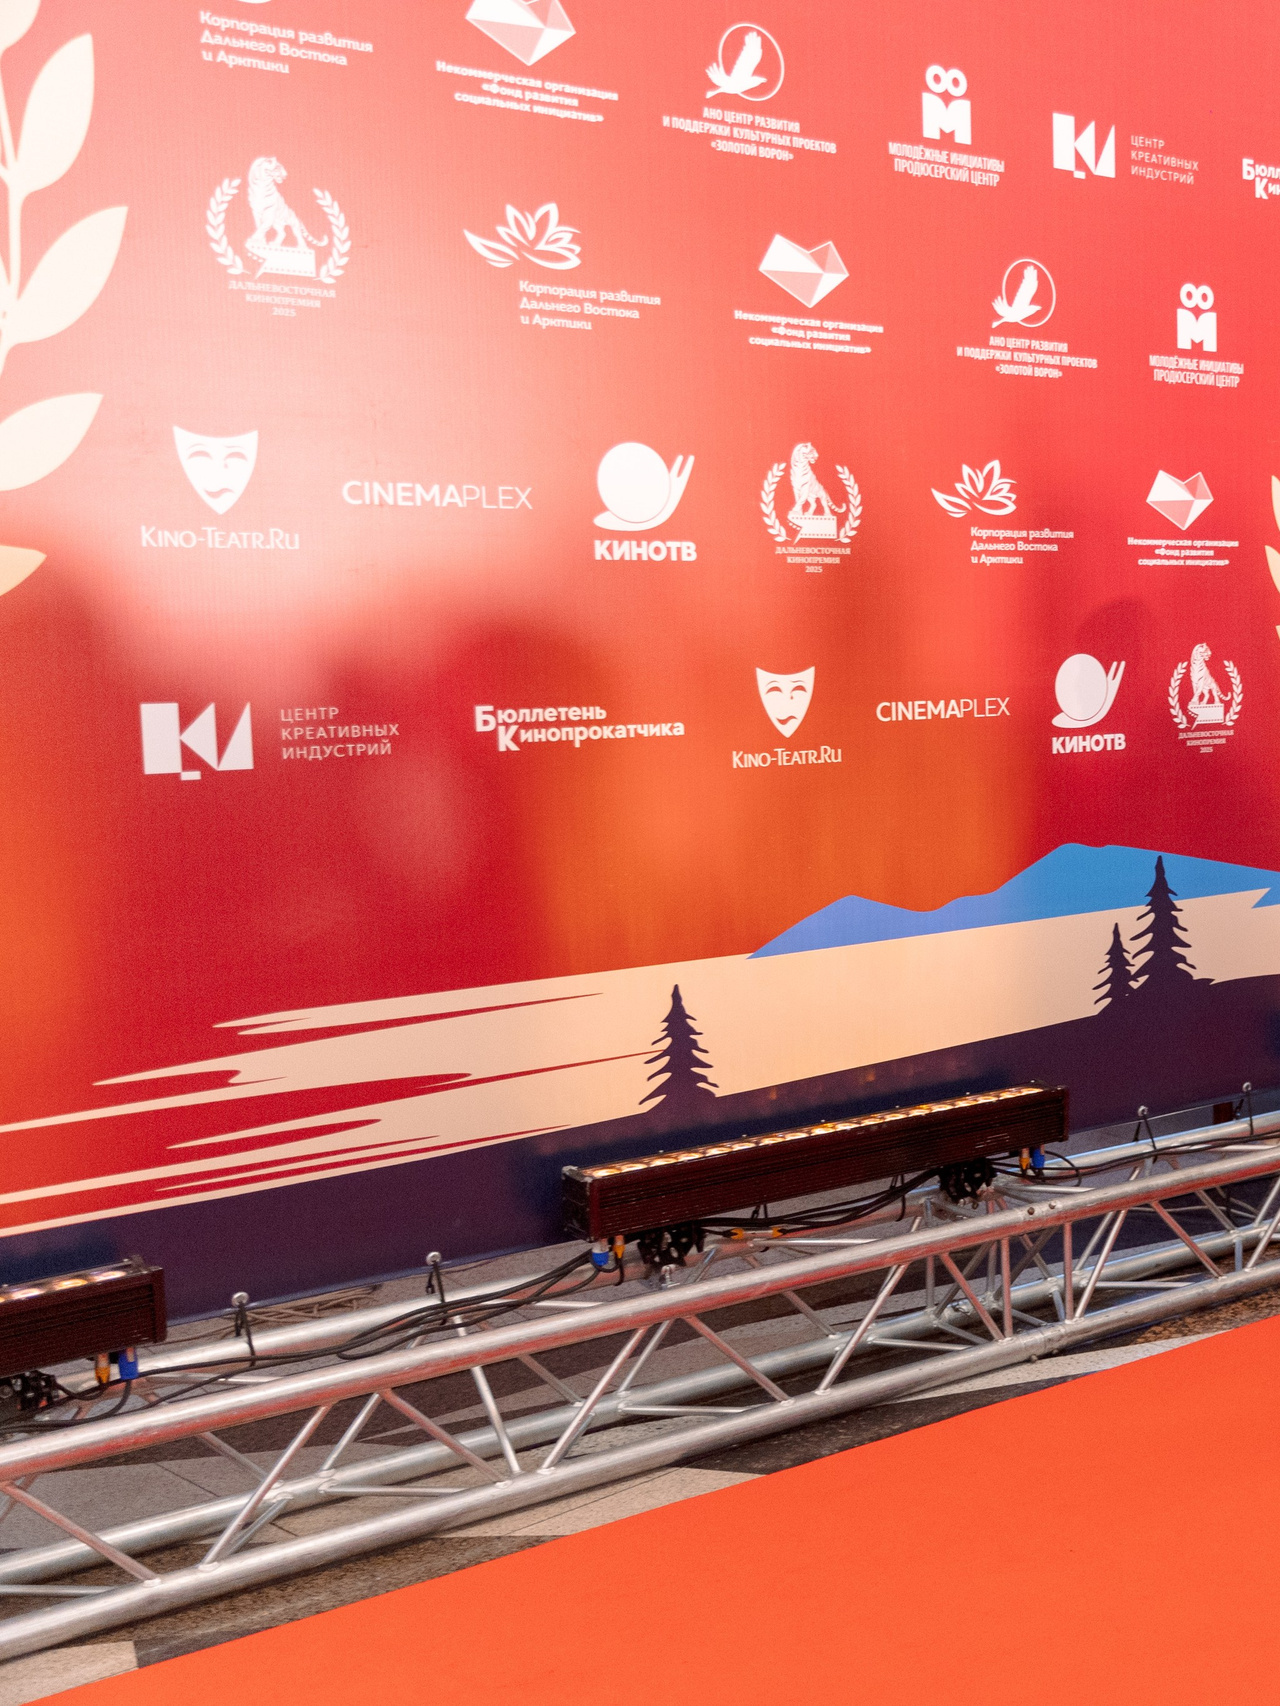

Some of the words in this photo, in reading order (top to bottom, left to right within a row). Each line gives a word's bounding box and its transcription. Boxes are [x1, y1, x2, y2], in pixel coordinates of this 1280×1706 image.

[199, 10, 295, 39] Корпорация
[298, 31, 373, 52] развития
[200, 29, 276, 53] Дальнего
[279, 42, 347, 66] Востока
[201, 50, 213, 61] и
[216, 50, 289, 74] Арктики
[435, 60, 543, 88] Некоммерческая
[544, 81, 619, 101] организация
[454, 92, 532, 112] социальных
[524, 91, 579, 107] развития
[703, 106, 723, 121] АНО
[724, 110, 754, 125] ЦЕНТР
[755, 115, 801, 133] РАЗВИТИЯ
[662, 115, 670, 127] И
[671, 116, 732, 137] ПОДДЕРЖКИ
[733, 126, 792, 147] КУЛЬТУРНЫХ
[792, 136, 838, 154] ПРОЕКТОВ
[1130, 134, 1166, 150] ЦЕНТР
[888, 141, 950, 164] МОЛОДЁЖНЫЕ
[950, 151, 1005, 173] ИНИЦИАТИВЫ
[1130, 150, 1199, 172] КРЕАТИВНЫХ
[894, 157, 970, 183] ПРОДЮСЕРСКИЙ
[971, 169, 1001, 187] ЦЕНТР
[1130, 164, 1195, 185] ИНДУСТРИЙ
[228, 280, 337, 298] ДАЛЬНЕВОСТОЧНАЯ
[519, 280, 597, 300] Корпорация
[598, 290, 662, 306] развития
[245, 293, 321, 308] КИНОПРЕМИЯ
[519, 296, 582, 314] Дальнего
[583, 302, 640, 319] Востока
[272, 307, 297, 318] 2025
[520, 314, 530, 325] и
[532, 313, 593, 331] Арктики
[989, 335, 1005, 347] АНО
[1006, 337, 1030, 349] ЦЕНТР
[1216, 374, 1241, 389] ЦЕНТР
[341, 480, 534, 510] CINEMAPLEX
[970, 526, 1028, 540] Корпорация
[1028, 527, 1075, 541] развития
[593, 539, 698, 562] КИНОТВ
[970, 540, 1016, 552] Дальнего
[1016, 541, 1059, 552] Востока
[979, 553, 1024, 567] Арктики
[280, 706, 341, 724] ЦЕНТР
[474, 703, 608, 733] Бюллетень
[875, 697, 1011, 723] CINEMAPLEX
[281, 723, 400, 741] КРЕАТИВНЫХ
[497, 720, 685, 753] Кинопрокатчика
[281, 738, 393, 760] ИНДУСТРИЙ
[1051, 733, 1127, 755] КИНОТВ
